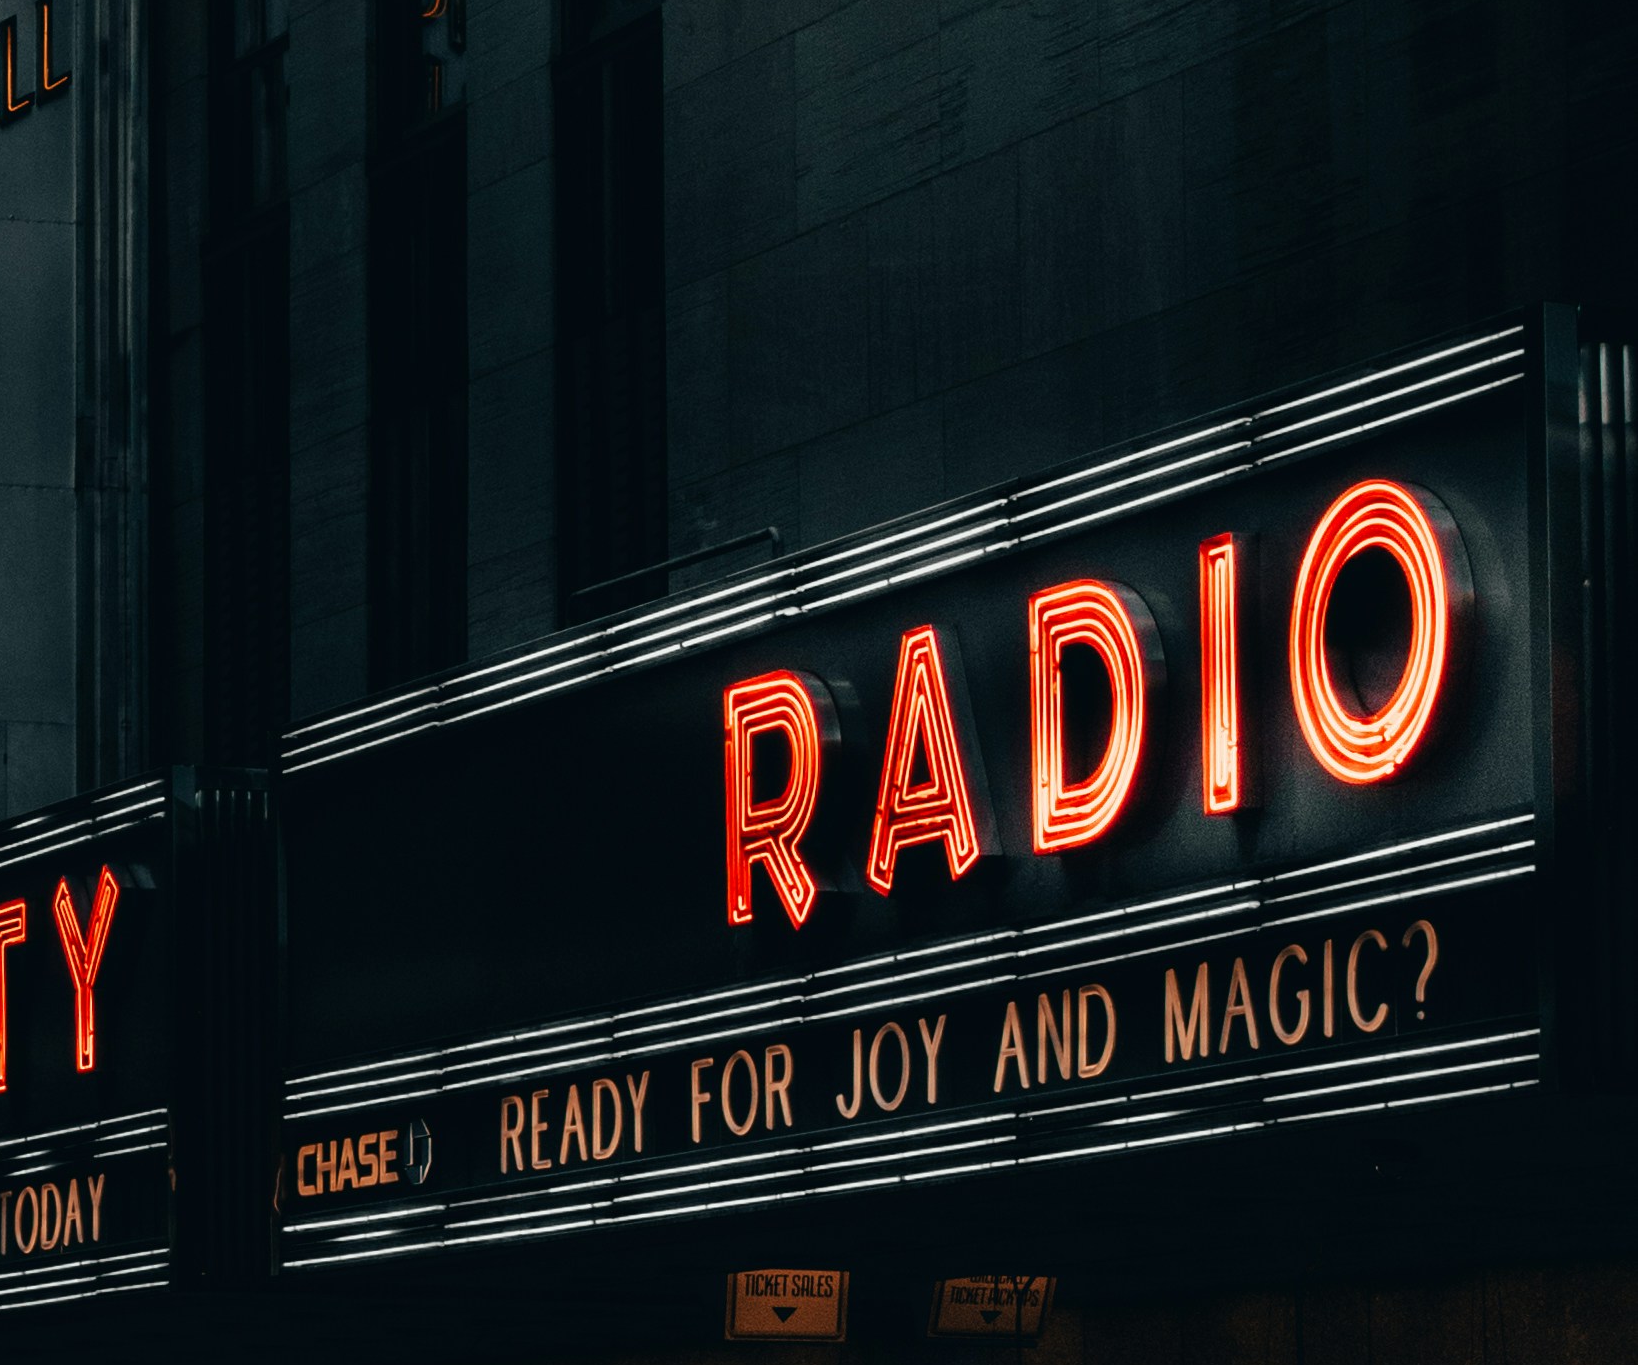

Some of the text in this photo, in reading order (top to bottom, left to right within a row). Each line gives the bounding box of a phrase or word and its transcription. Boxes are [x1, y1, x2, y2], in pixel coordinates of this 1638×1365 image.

[723, 478, 1448, 931] RADIO
[500, 919, 1439, 1173] READY FOR JOY AND MAGIC?
[297, 1130, 399, 1197] CHASE
[0, 1173, 105, 1256] TODAY
[744, 1274, 834, 1298] TICKET SALES
